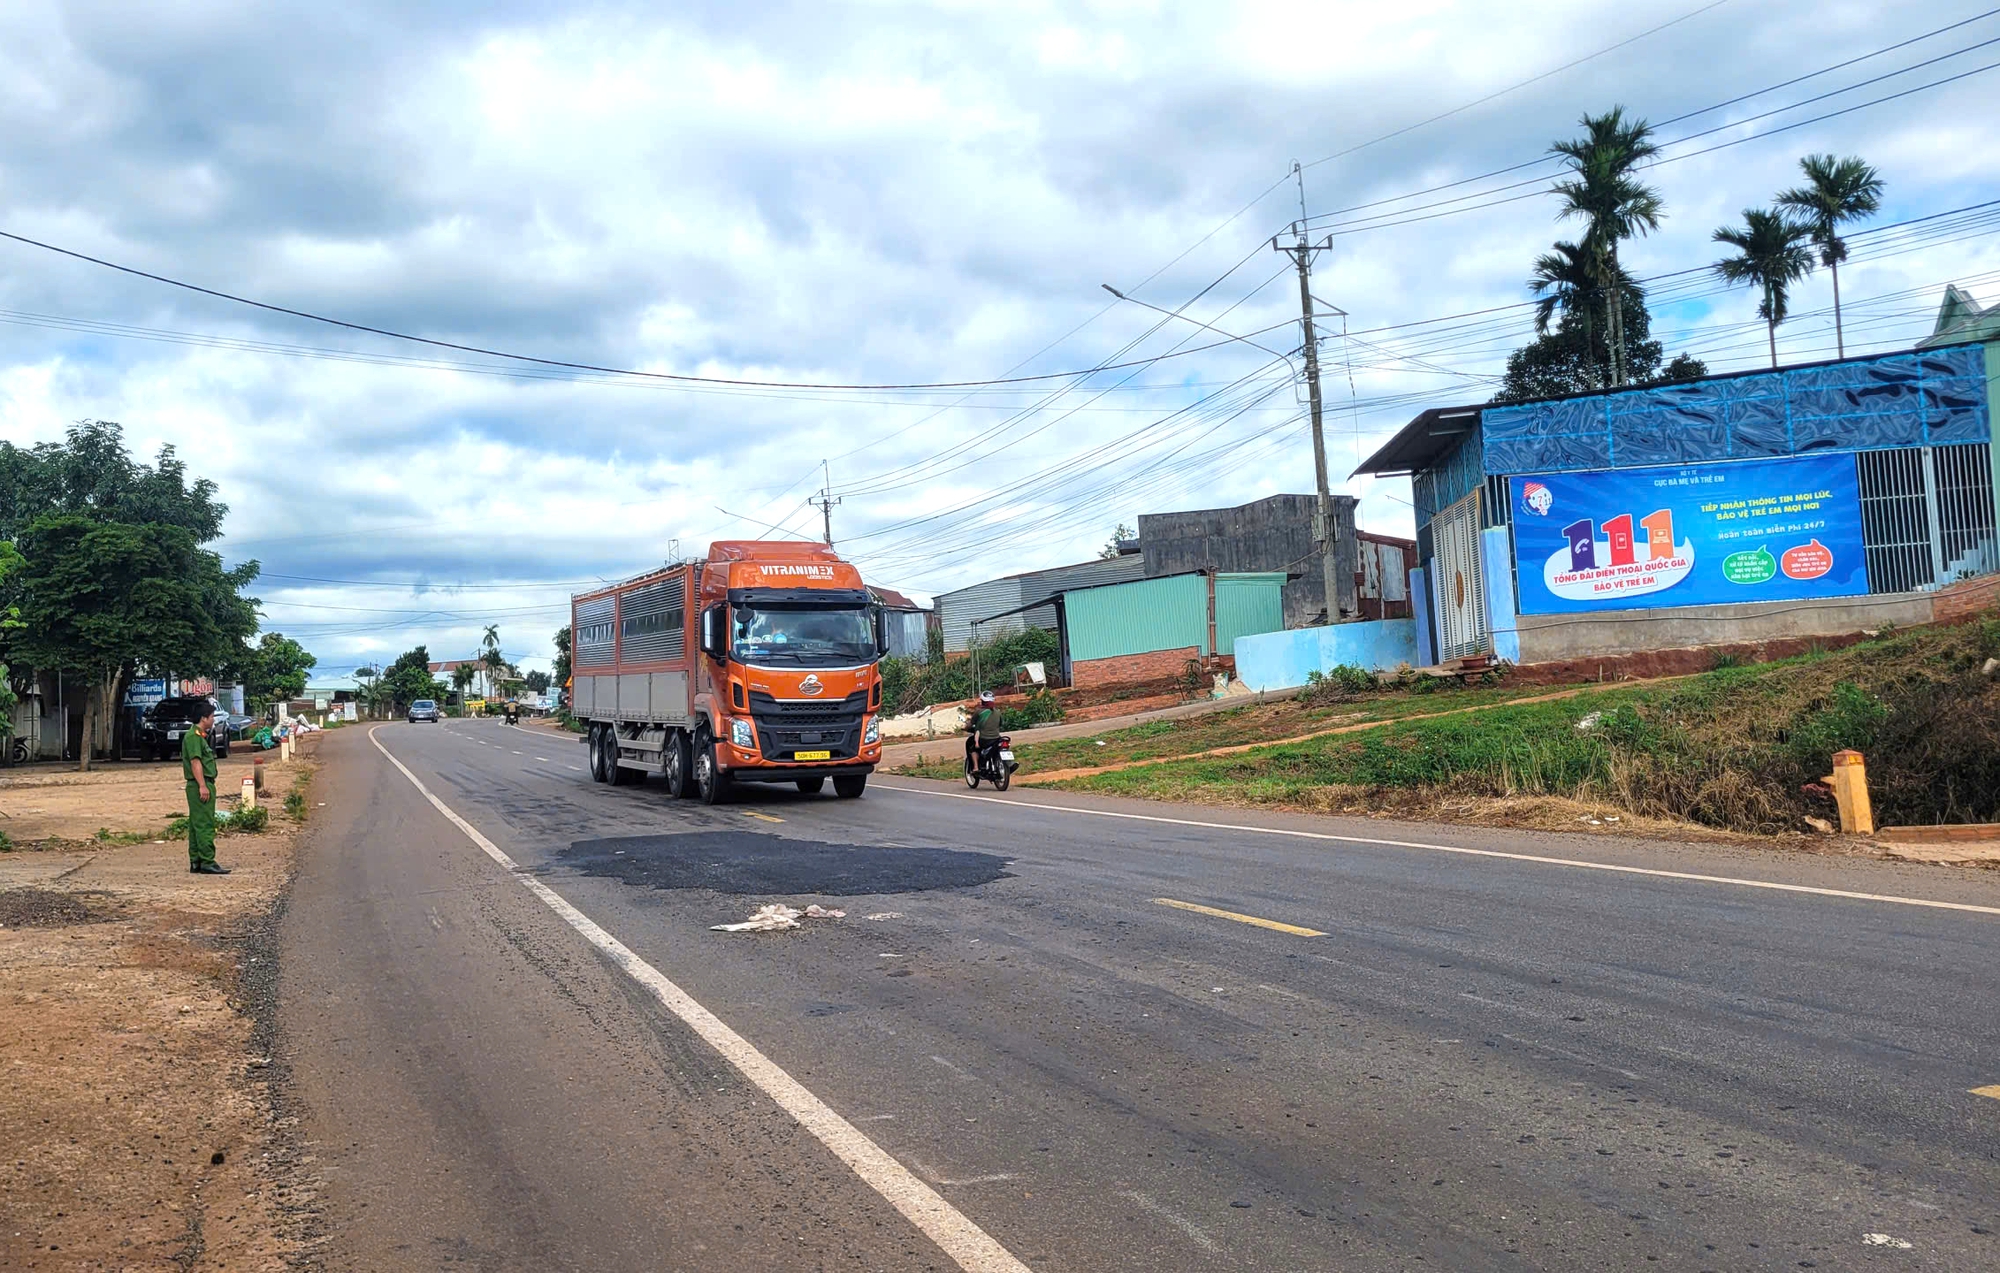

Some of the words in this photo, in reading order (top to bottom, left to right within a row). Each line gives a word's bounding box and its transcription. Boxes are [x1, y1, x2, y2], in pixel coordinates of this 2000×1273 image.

[1654, 479, 1668, 487] CỤC
[1668, 478, 1678, 486] BÀ
[1678, 477, 1689, 485] MẸ
[1689, 476, 1700, 484] VÀ
[1700, 474, 1713, 483] TRẺ
[1713, 475, 1725, 483] EM
[1700, 502, 1718, 512] TIẾP
[1720, 500, 1746, 510] NHẬN
[1747, 497, 1777, 507] THÔNG
[1778, 495, 1794, 503] TIN
[1795, 494, 1813, 502] MỌI
[1716, 510, 1736, 520] BẢO
[1738, 509, 1749, 519] VỆ
[1750, 507, 1767, 517] TRẺ
[1784, 504, 1802, 513] MỌI
[1803, 502, 1820, 510] NƠI
[1803, 520, 1825, 530] 24/7
[760, 565, 834, 575] VITRANIMEX
[1553, 572, 1577, 584] TỔNG
[1579, 570, 1594, 580] ĐÀI
[1596, 568, 1615, 580] ĐIỆN
[1616, 565, 1643, 576] THOẠI
[1644, 559, 1669, 571] QUỐC
[1671, 558, 1687, 568] GIA
[1594, 580, 1612, 591] BẢO
[1613, 580, 1624, 590] VỆ
[1626, 577, 1640, 587] TRẺ
[1642, 576, 1655, 584] EM
[131, 683, 162, 692] Billiards
